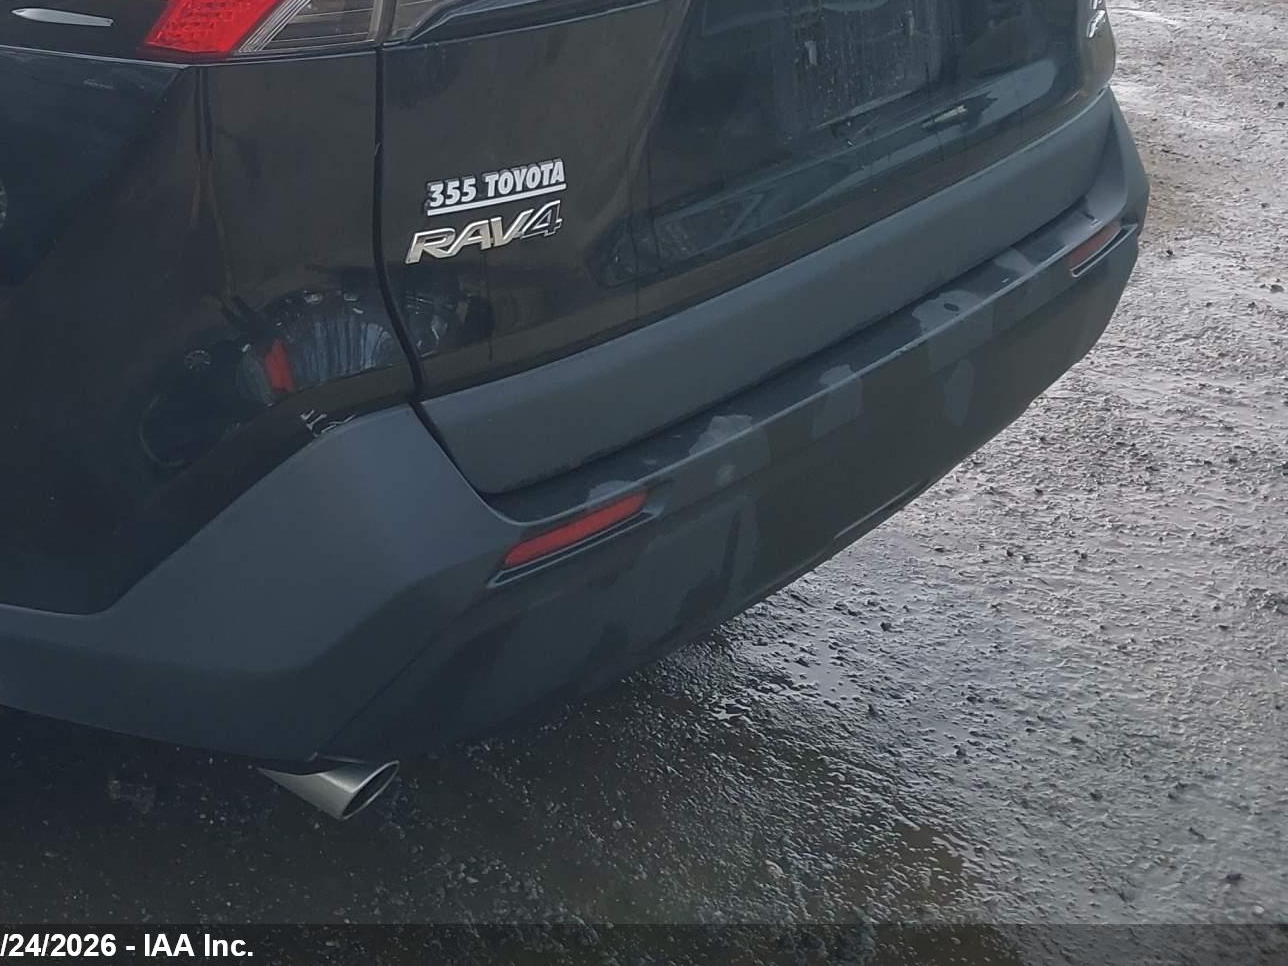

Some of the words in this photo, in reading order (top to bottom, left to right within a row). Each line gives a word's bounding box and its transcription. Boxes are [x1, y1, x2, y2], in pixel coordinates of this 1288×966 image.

[427, 176, 476, 208] 355
[483, 159, 566, 198] TOYOTA
[405, 199, 563, 264] RAV4
